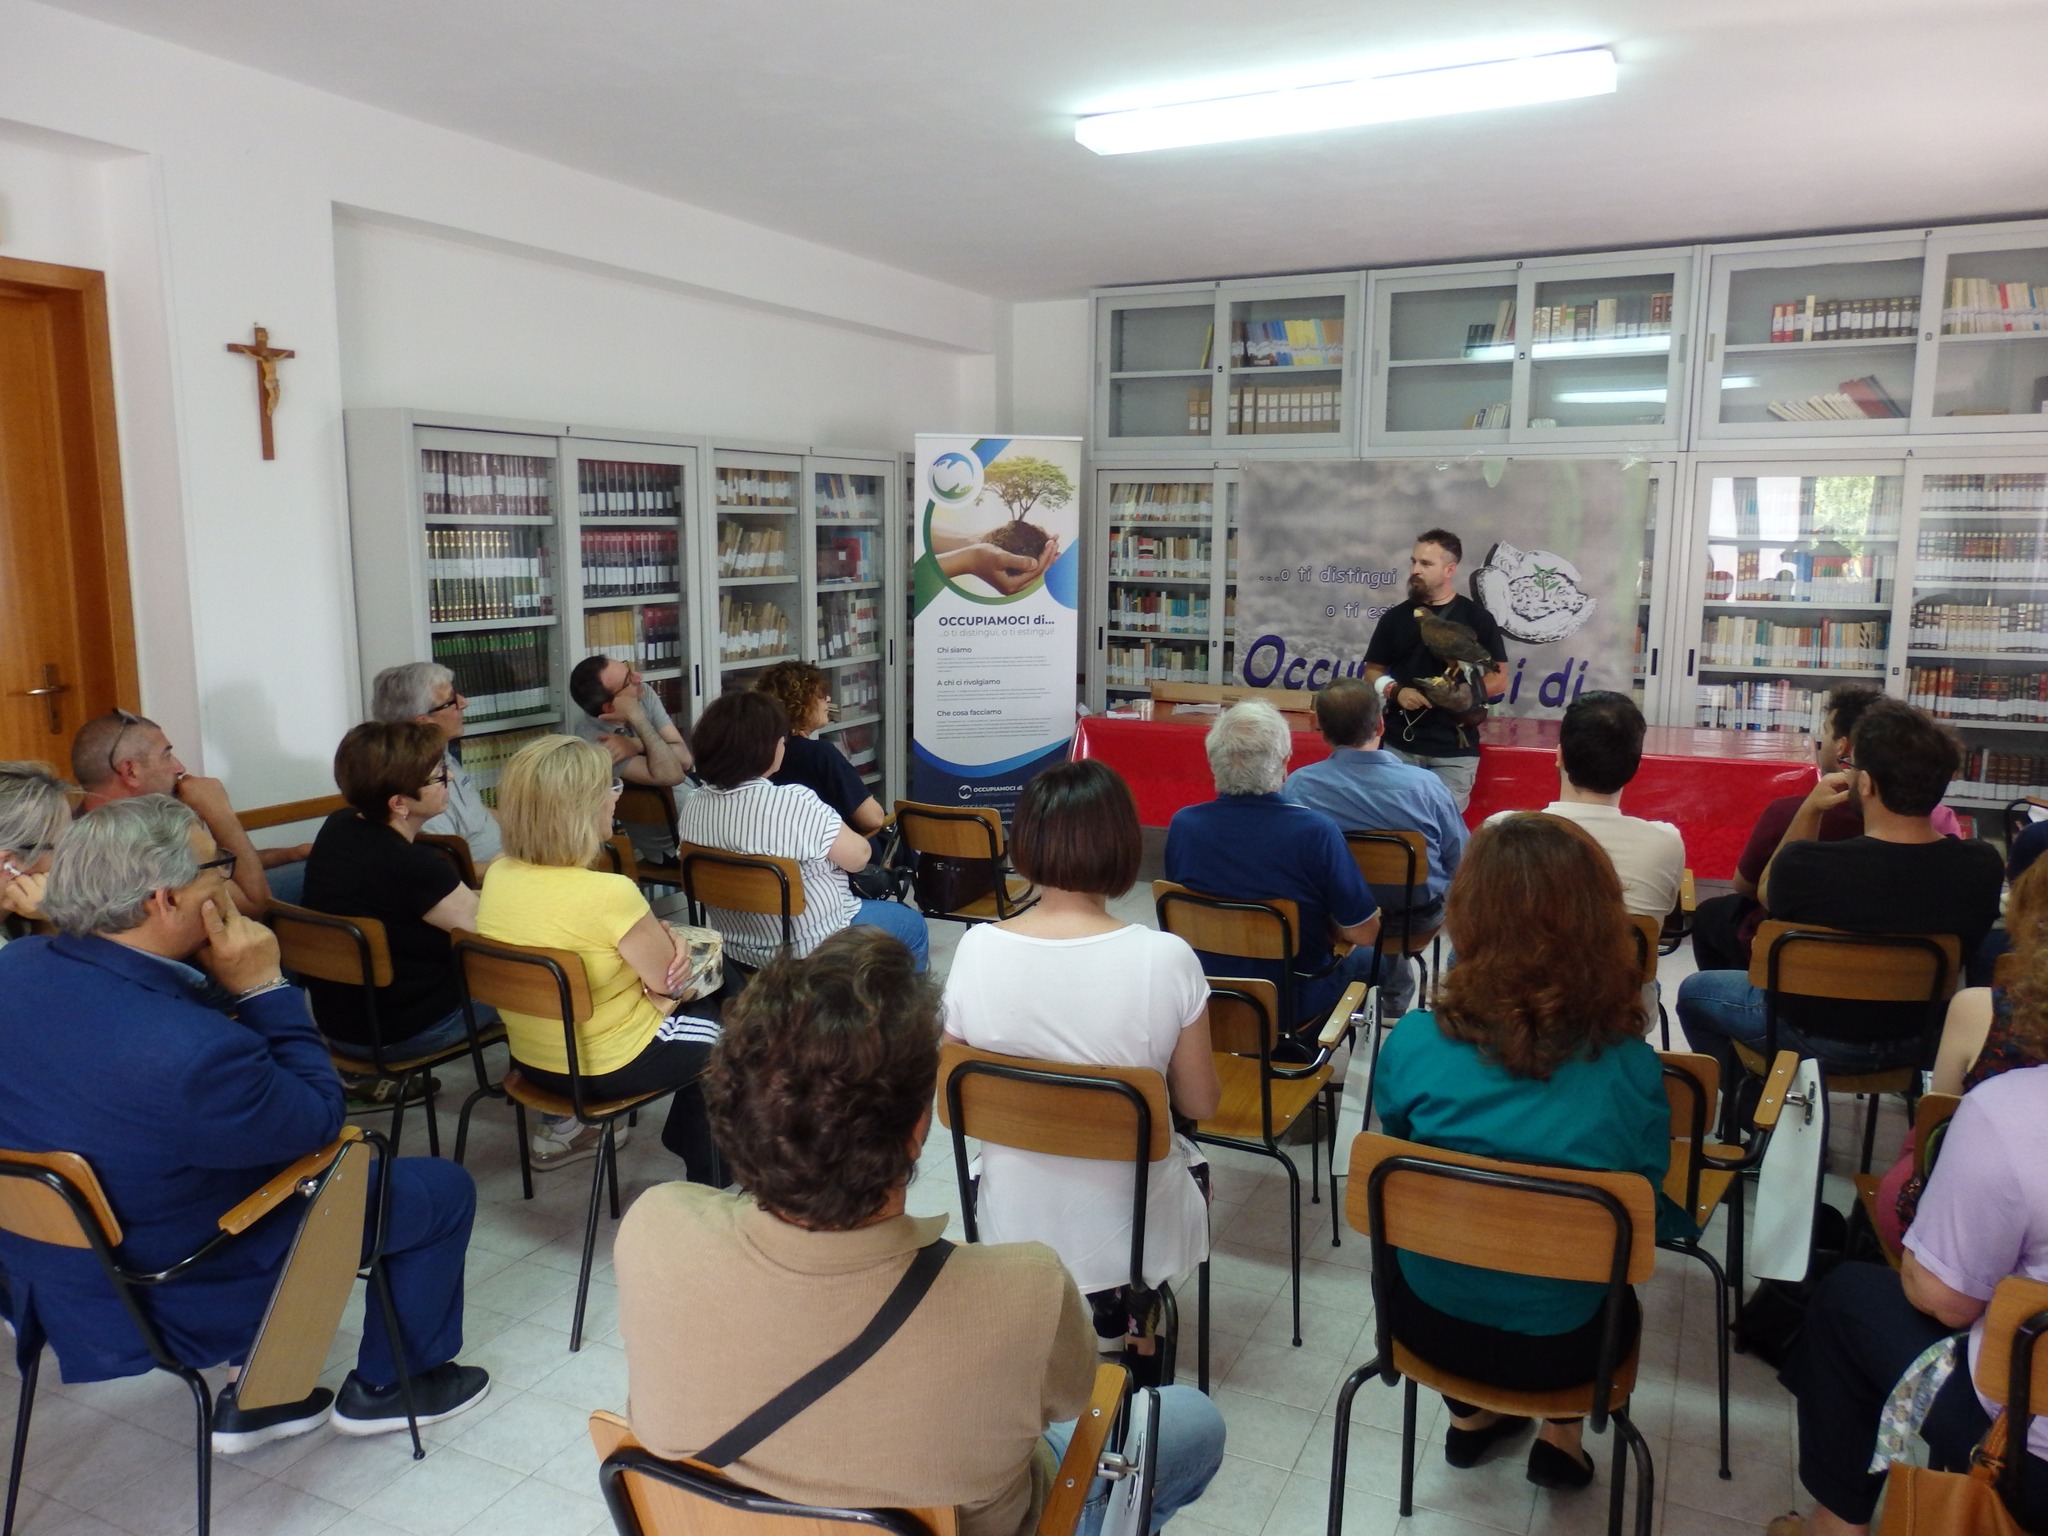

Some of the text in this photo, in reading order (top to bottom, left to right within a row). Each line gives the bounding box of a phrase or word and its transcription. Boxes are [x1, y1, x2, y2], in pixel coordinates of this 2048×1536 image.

[1298, 565, 1312, 582] ti
[1319, 565, 1398, 589] distingui
[1325, 604, 1336, 617] o
[1344, 602, 1359, 618] ti
[938, 614, 1055, 626] OCCUPIAMOCI di...
[937, 646, 972, 654] Chi siamo
[963, 678, 1001, 687] rivolgiamo
[1538, 656, 1589, 708] di
[936, 709, 951, 717] Che
[969, 708, 1002, 717] facciamo
[973, 785, 1016, 793] OCCUPIAMOCI
